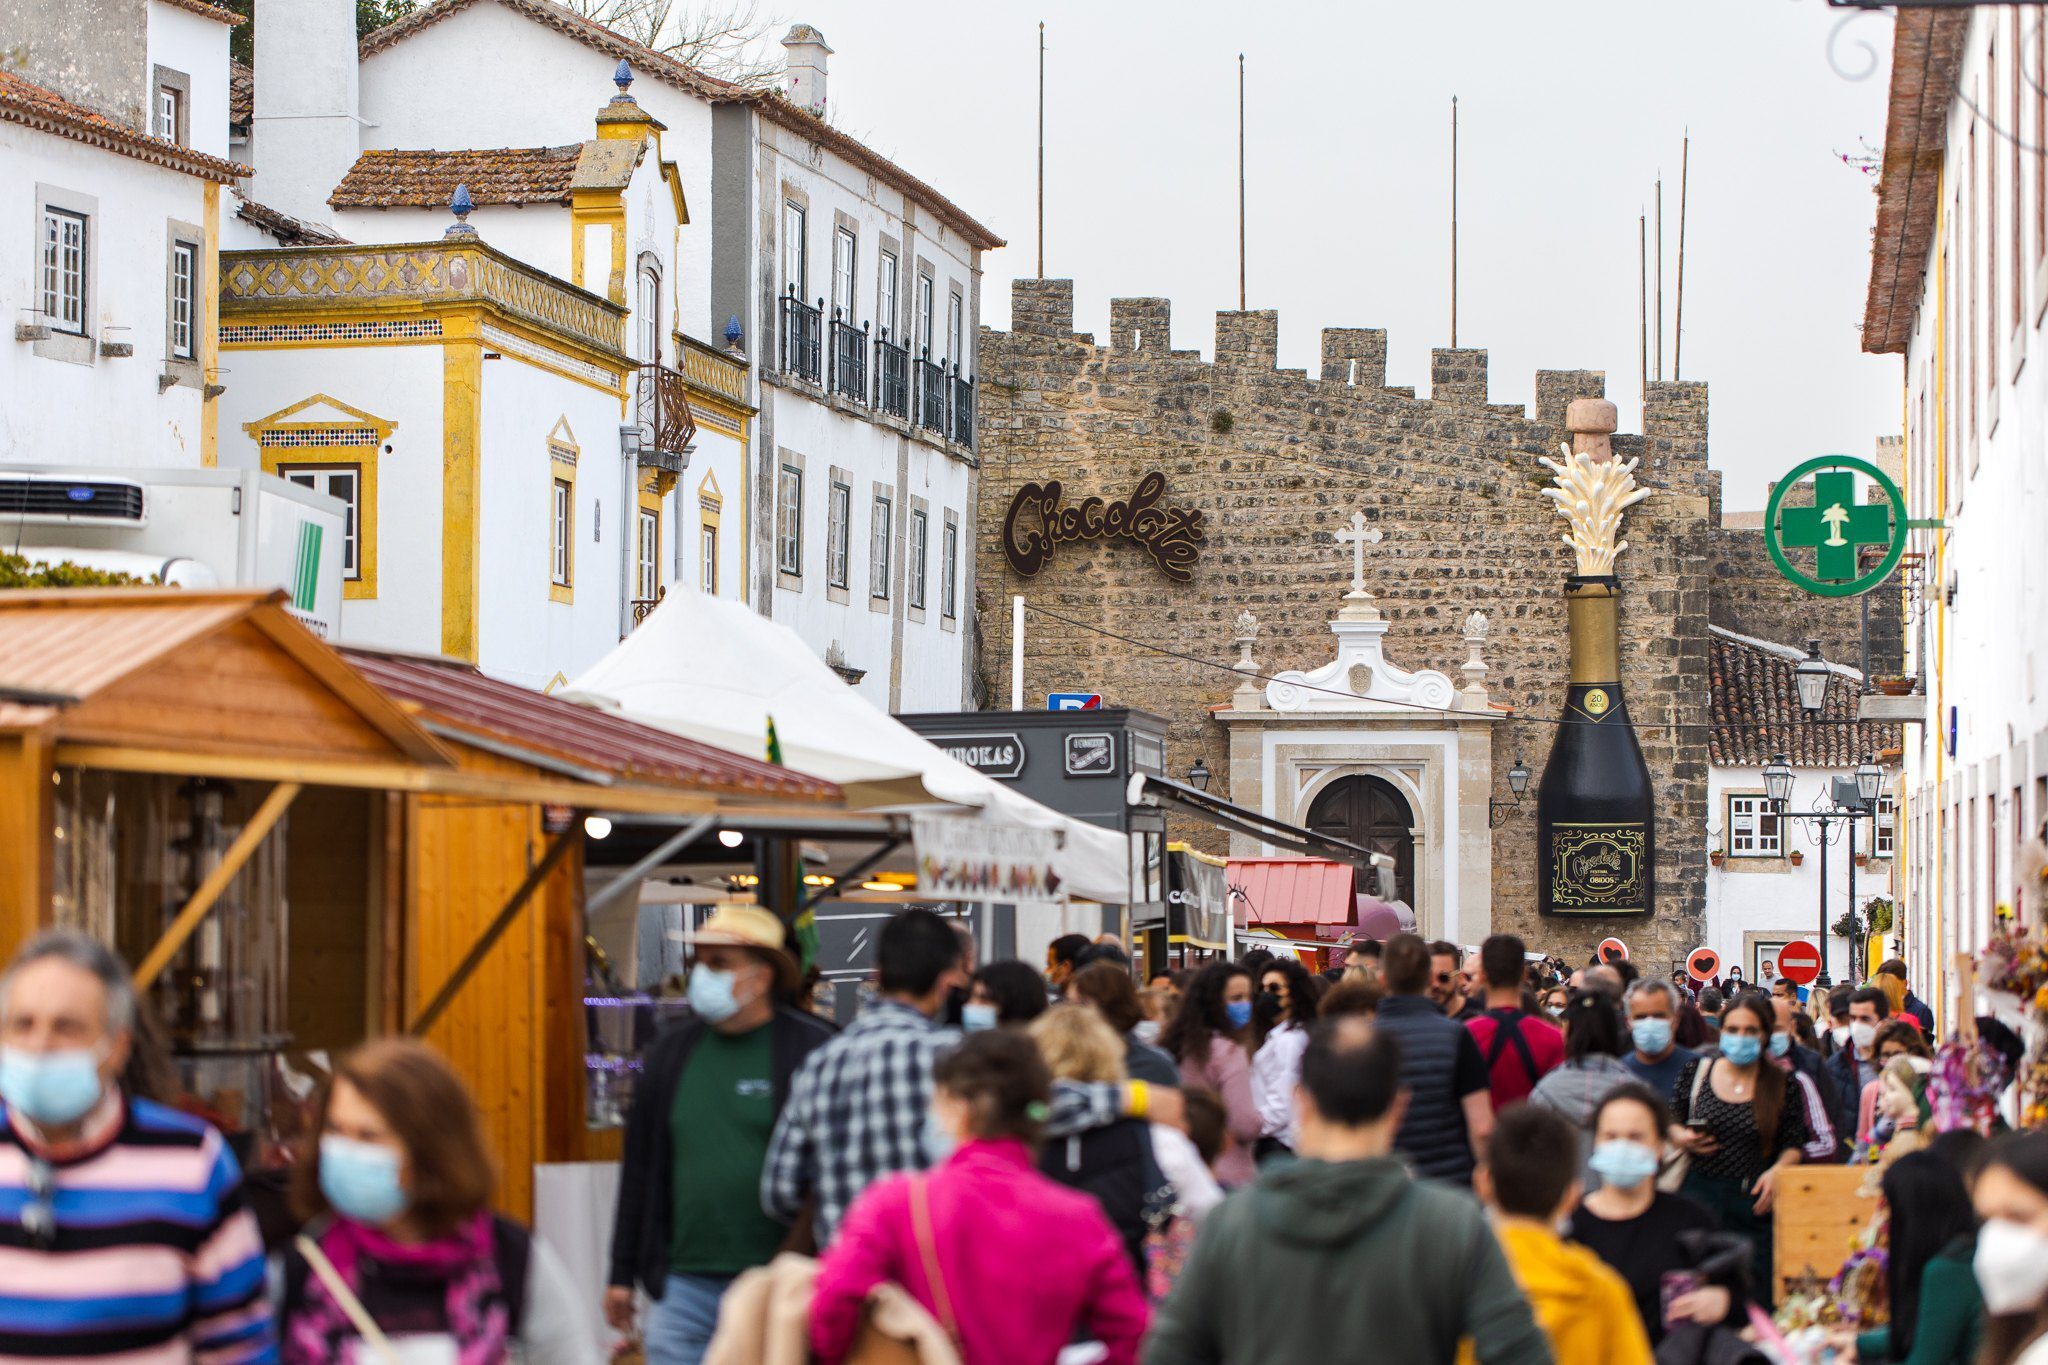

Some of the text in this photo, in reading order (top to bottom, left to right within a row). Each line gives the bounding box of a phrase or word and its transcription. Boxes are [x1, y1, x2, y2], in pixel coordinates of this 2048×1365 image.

[1003, 471, 1204, 581] Chocolate
[1591, 694, 1602, 703] 20
[1572, 845, 1621, 881] Chocolate
